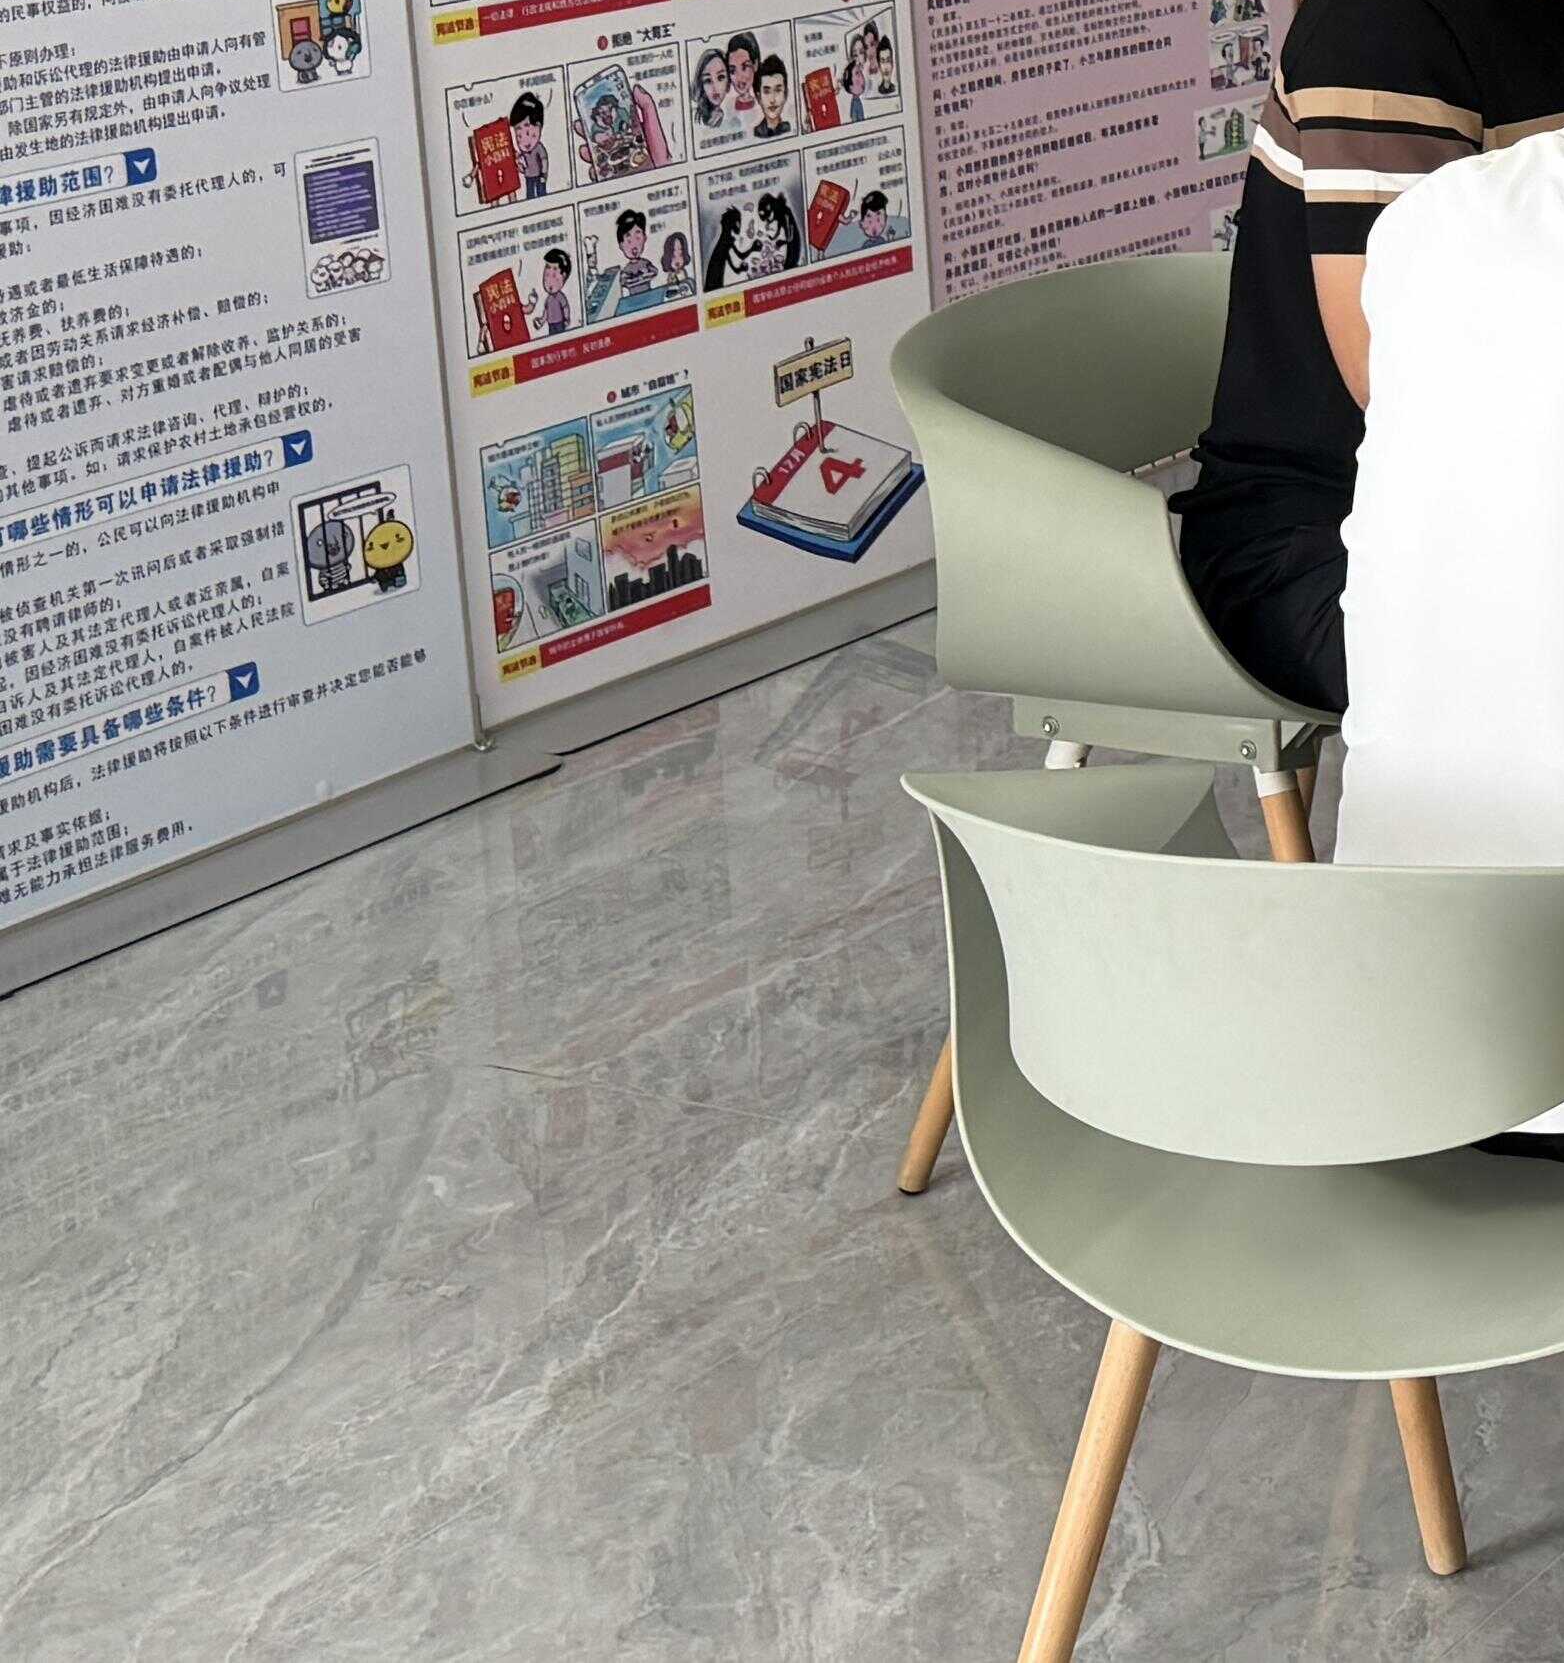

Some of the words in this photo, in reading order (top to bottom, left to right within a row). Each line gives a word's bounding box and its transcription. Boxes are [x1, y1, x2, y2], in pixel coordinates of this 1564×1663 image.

[779, 351, 853, 394] 国家宪法日
[818, 456, 867, 495] 4
[0, 449, 273, 547] 哪些情形可以申请法律援助？
